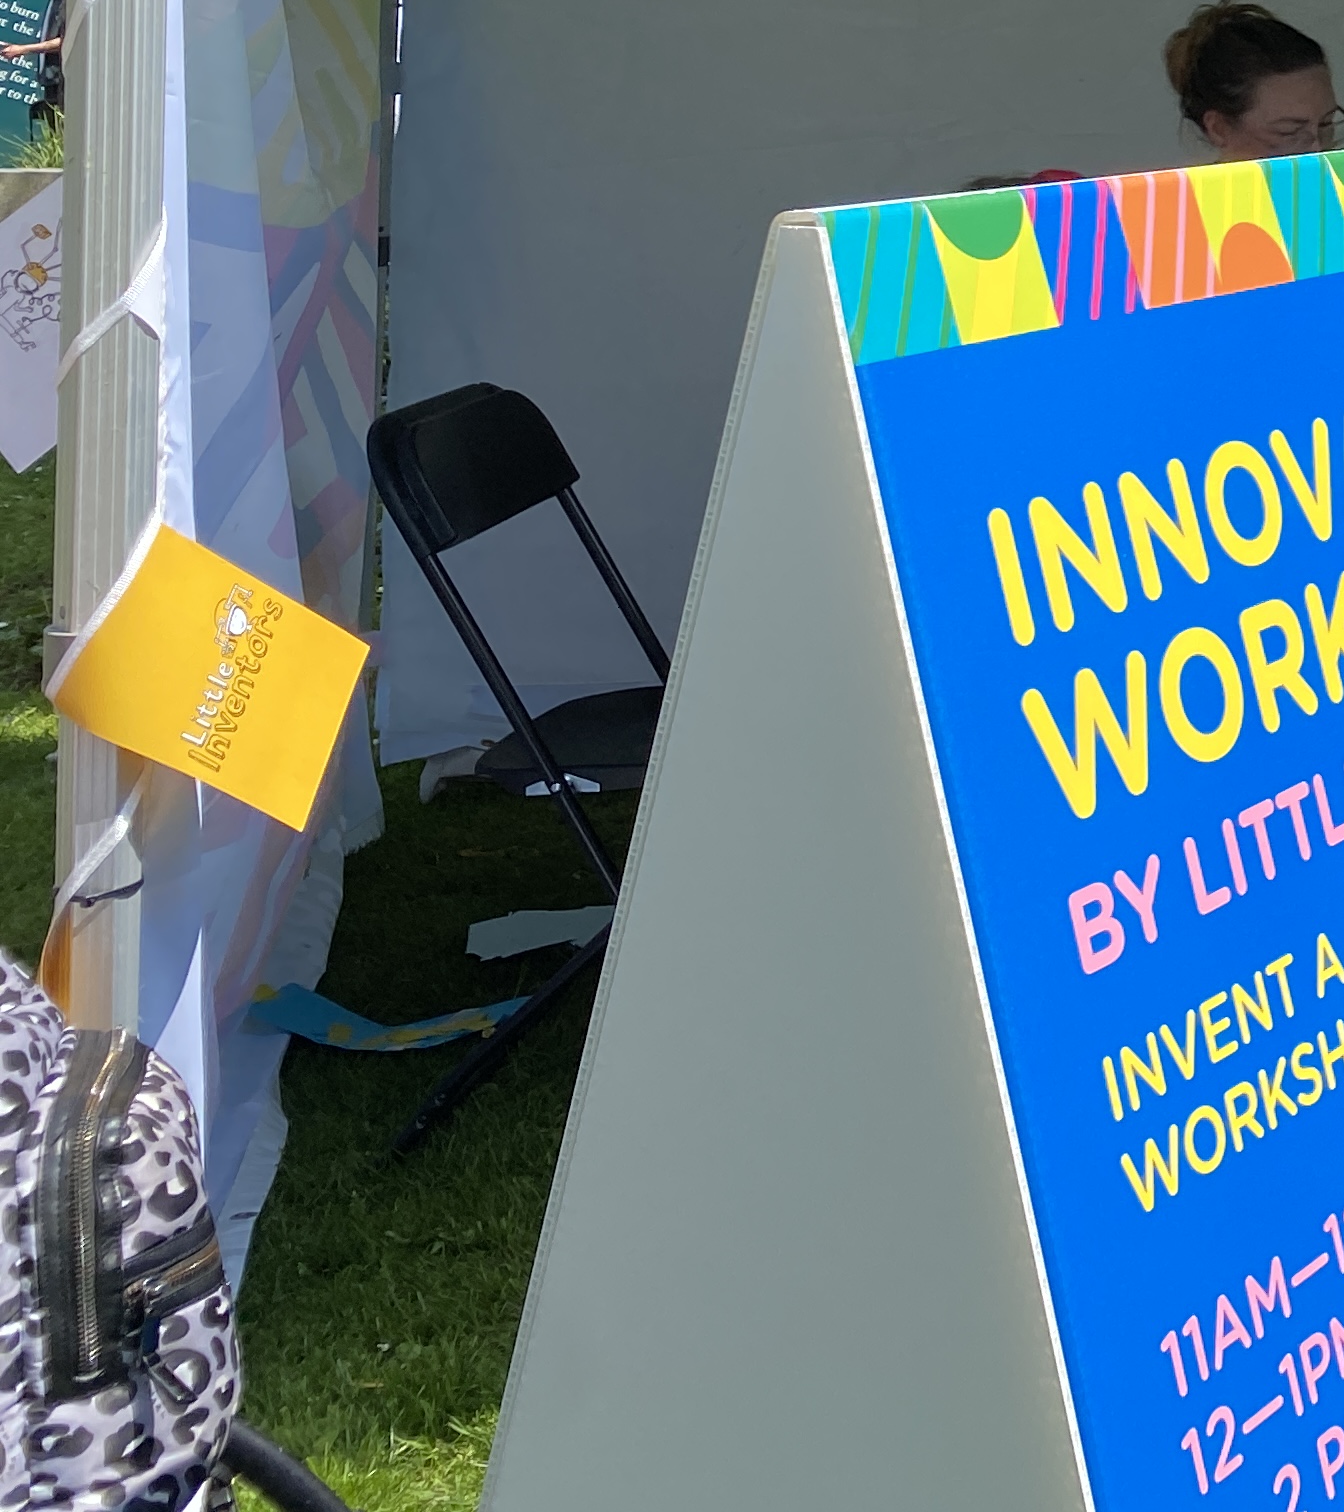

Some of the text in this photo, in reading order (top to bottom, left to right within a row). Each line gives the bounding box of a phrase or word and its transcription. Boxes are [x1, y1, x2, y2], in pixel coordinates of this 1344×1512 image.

[180, 661, 234, 748] Little
[188, 597, 284, 773] Inventors
[1068, 854, 1160, 975] BY
[1103, 953, 1294, 1121] INVENT
